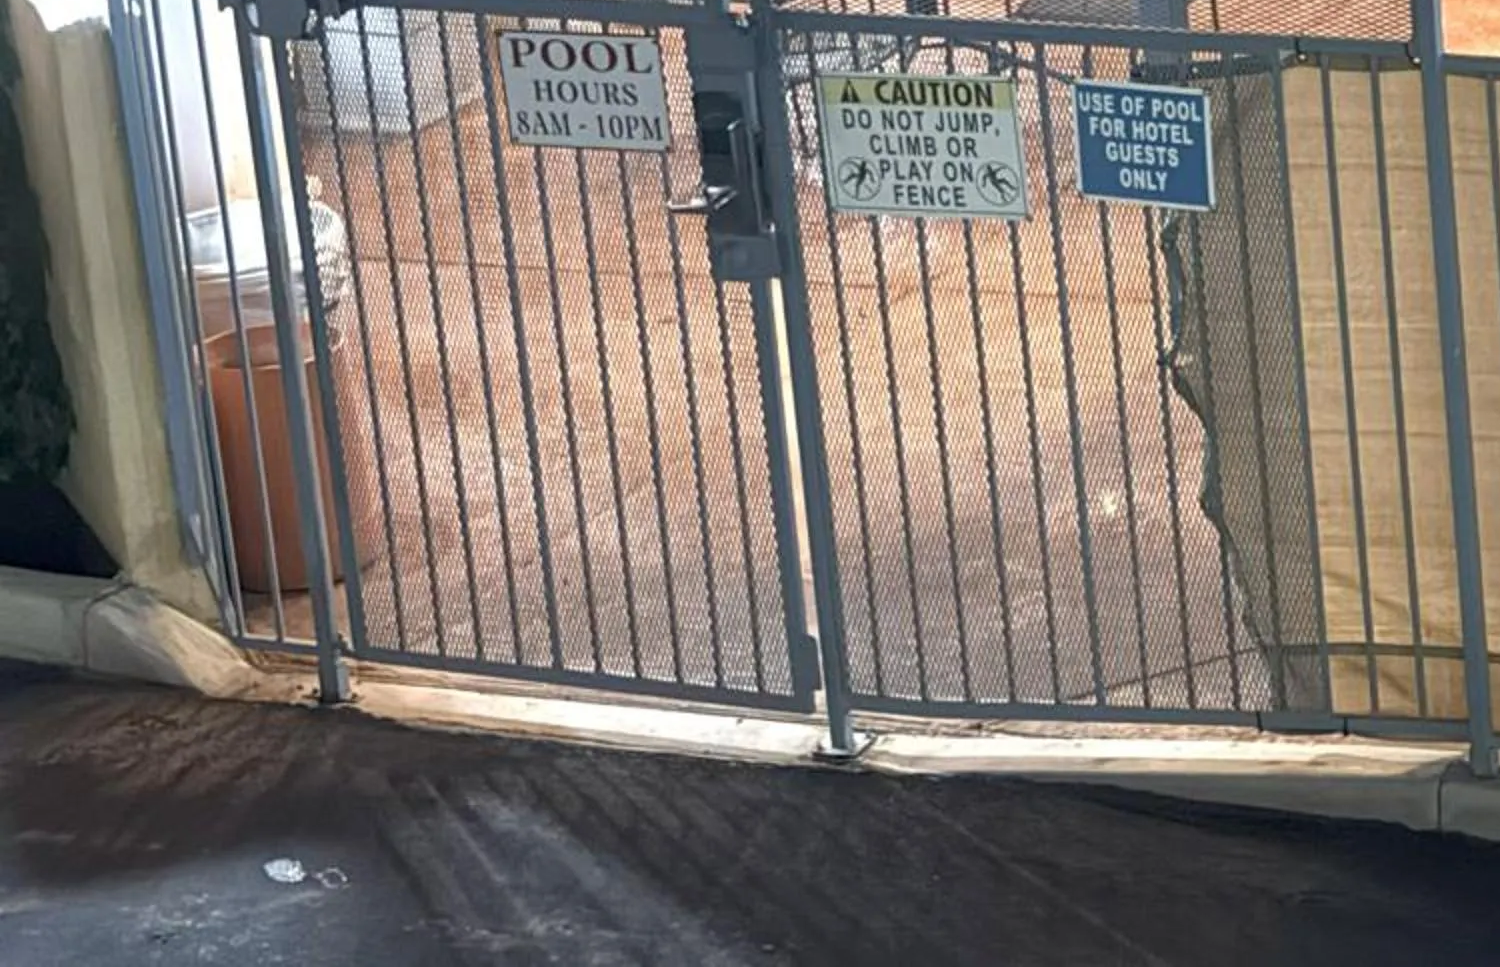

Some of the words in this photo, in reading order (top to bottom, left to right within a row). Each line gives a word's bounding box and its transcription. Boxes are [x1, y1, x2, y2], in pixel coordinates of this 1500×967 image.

[507, 38, 653, 74] POOL
[533, 80, 639, 106] HOURS
[874, 80, 993, 107] CAUTION
[1079, 91, 1115, 114] USE
[1121, 95, 1144, 116] OF
[1151, 98, 1202, 122] POOL
[517, 110, 572, 136] 8AM
[596, 114, 664, 141] 10PM
[842, 108, 872, 130] DO
[881, 110, 925, 131] NOT
[935, 112, 1000, 137] JUMP,
[1088, 116, 1126, 138] FOR
[1131, 120, 1194, 145] HOTEL
[869, 134, 938, 156] CLIMB
[946, 137, 978, 158] OR
[1105, 141, 1179, 167] GUESTS
[879, 159, 934, 181] PLAY
[943, 161, 974, 182] ON
[1119, 168, 1168, 192] ONLY
[893, 184, 967, 207] FENCE
